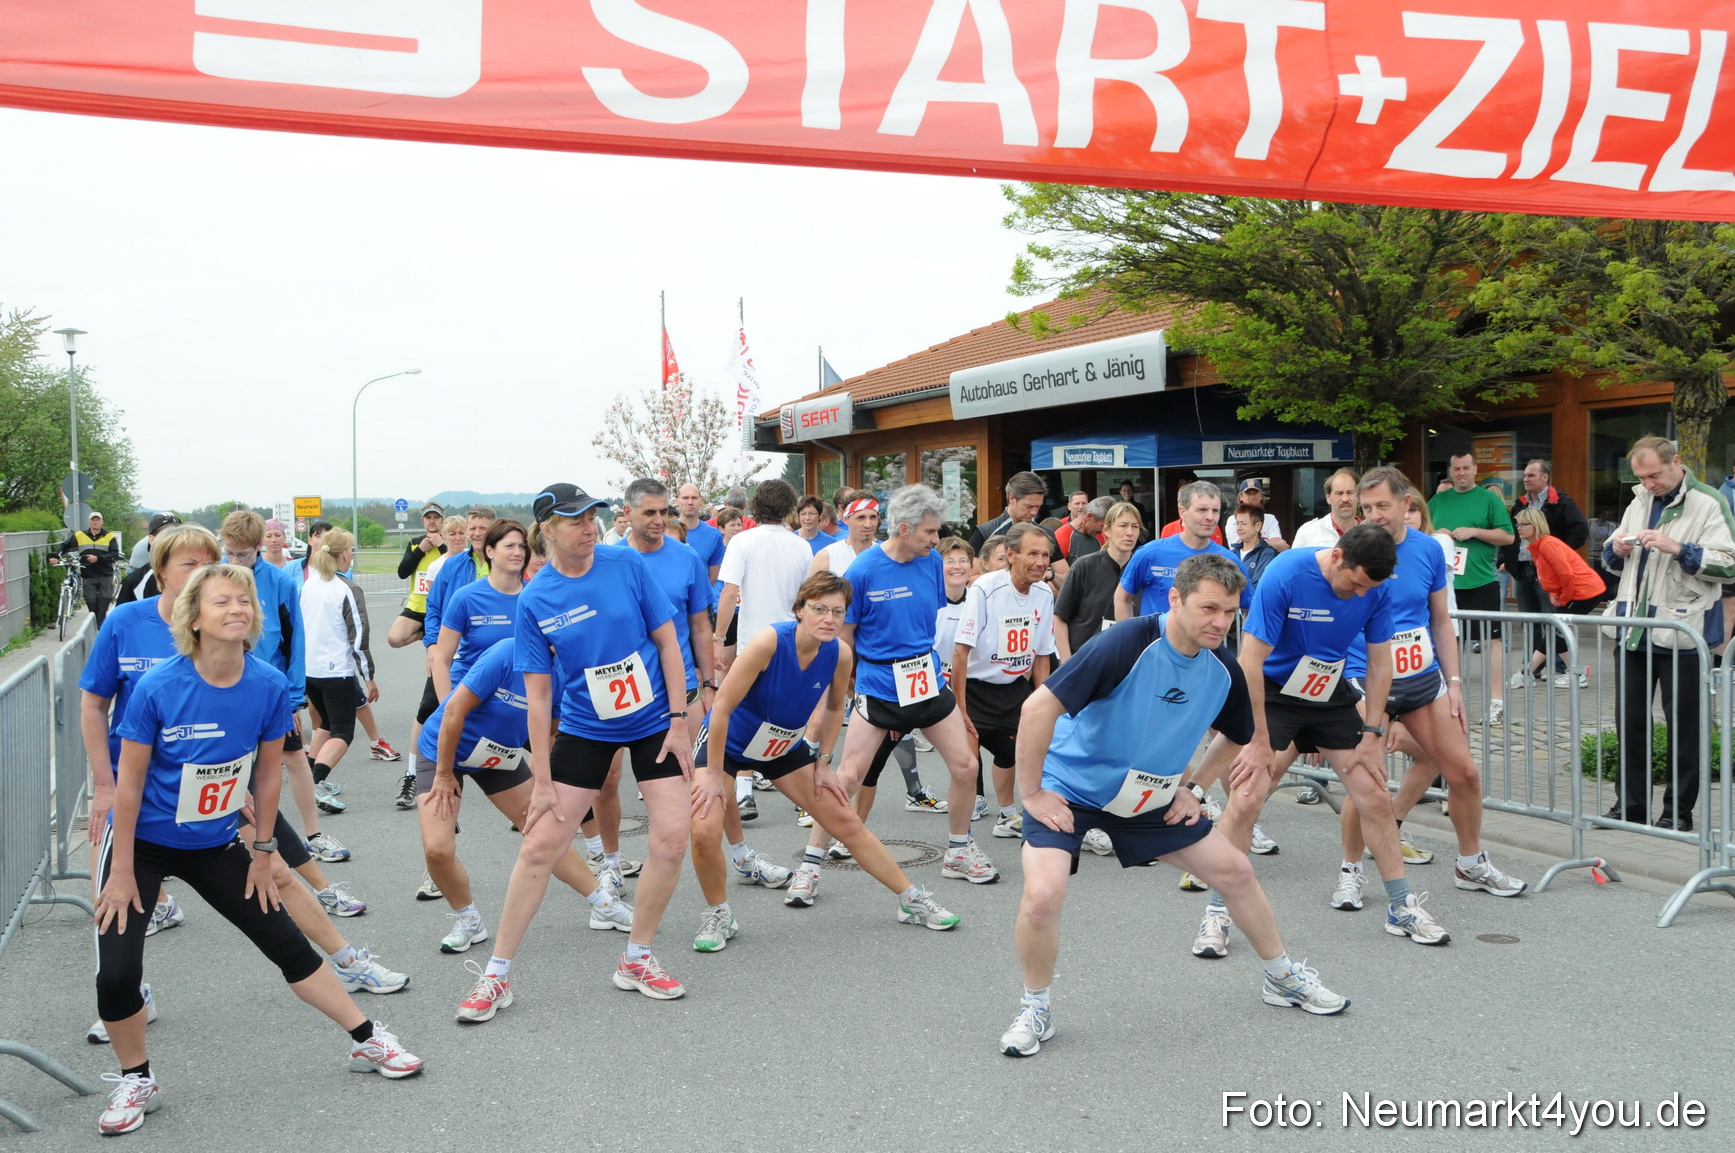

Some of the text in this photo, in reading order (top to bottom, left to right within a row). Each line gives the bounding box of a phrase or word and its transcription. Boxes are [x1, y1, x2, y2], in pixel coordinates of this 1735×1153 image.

[960, 354, 1145, 403] Autohaus Gerhart & Jänig
[801, 407, 839, 428] SEAT
[1228, 445, 1309, 459] Neumarkter Tagblatt
[1007, 628, 1028, 653] 86
[901, 661, 920, 669] MEYER
[1310, 661, 1333, 671] MEYER
[1395, 644, 1422, 673] 66
[595, 664, 622, 676] MEYER
[609, 674, 641, 711] 21
[906, 670, 929, 698] 73
[1300, 673, 1330, 697] 16
[769, 726, 792, 736] MEYER
[487, 743, 510, 754] MEYER
[762, 738, 791, 757] 10
[196, 766, 231, 775] MEYER
[1136, 774, 1164, 784] MEYER
[198, 777, 238, 815] 67
[1132, 789, 1154, 813] 1
